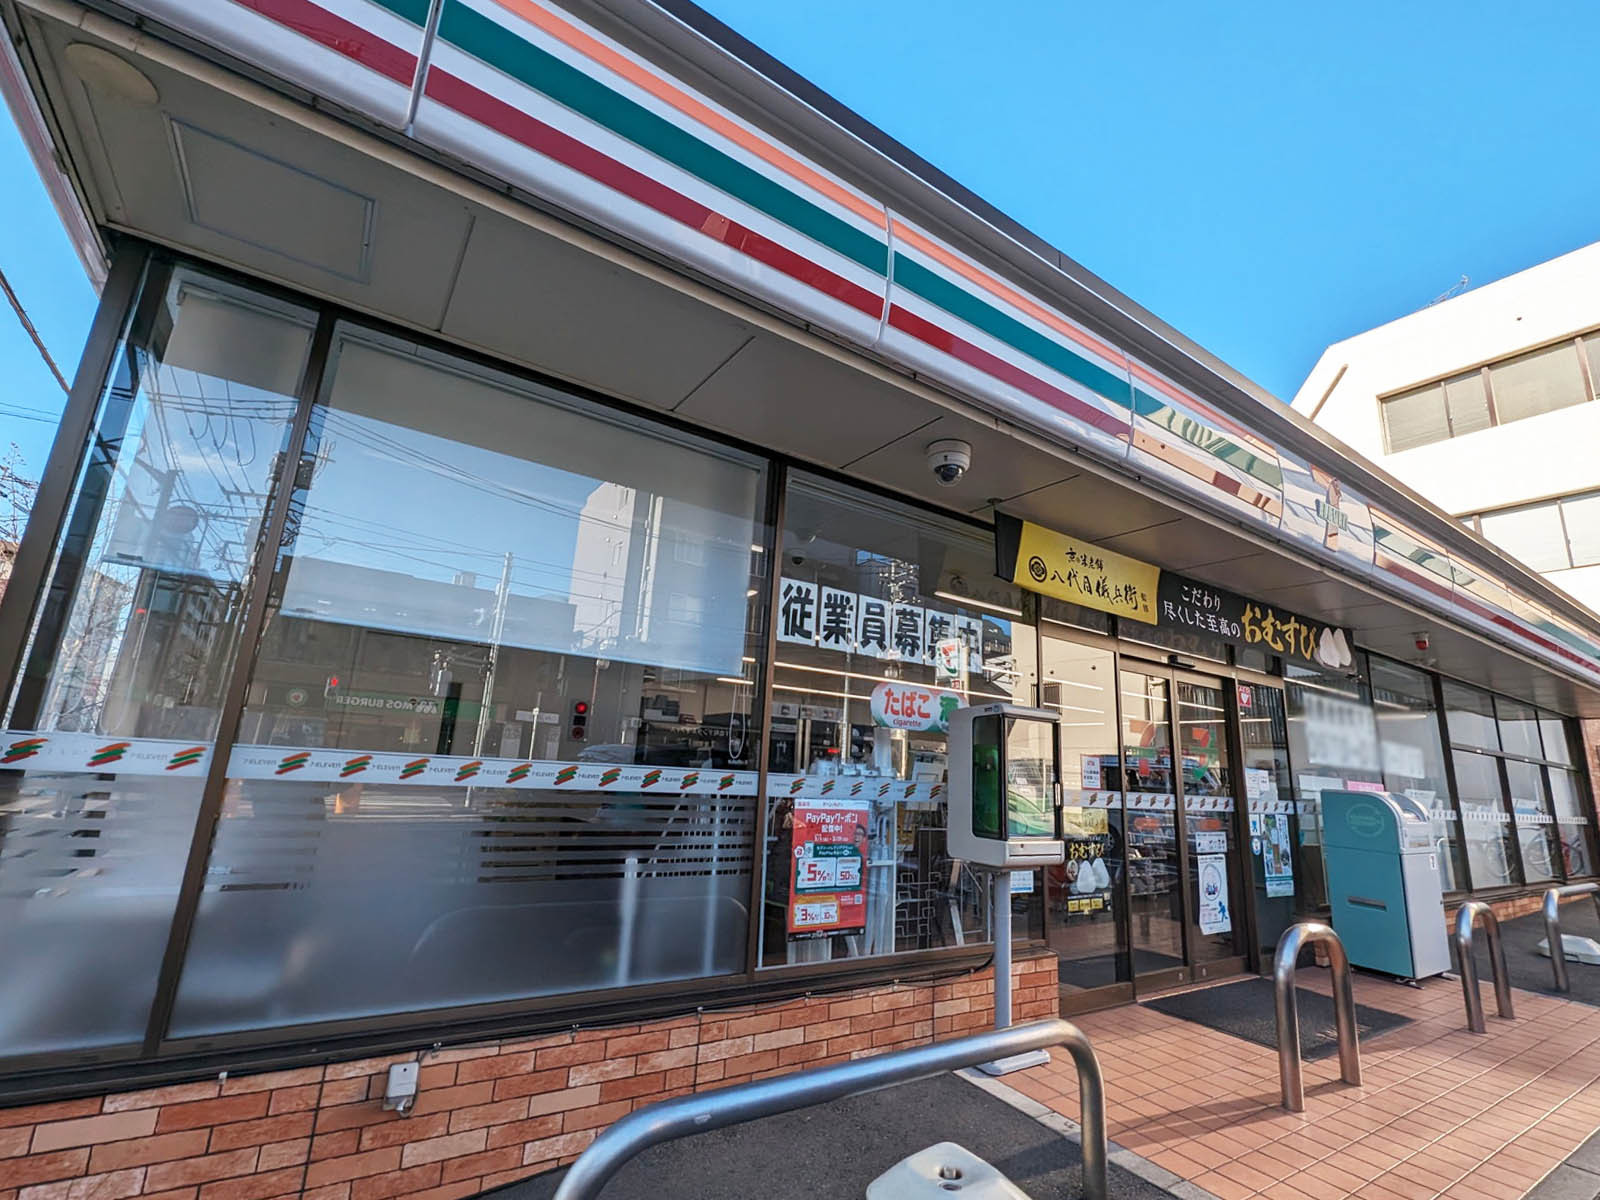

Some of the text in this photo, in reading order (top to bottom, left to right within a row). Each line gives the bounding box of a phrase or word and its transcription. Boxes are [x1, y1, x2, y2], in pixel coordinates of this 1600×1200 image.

[1181, 585, 1221, 612] こだわり
[1163, 600, 1241, 638] 尽くした至高の
[1241, 603, 1317, 661] おむすび
[884, 688, 931, 718] たばこ
